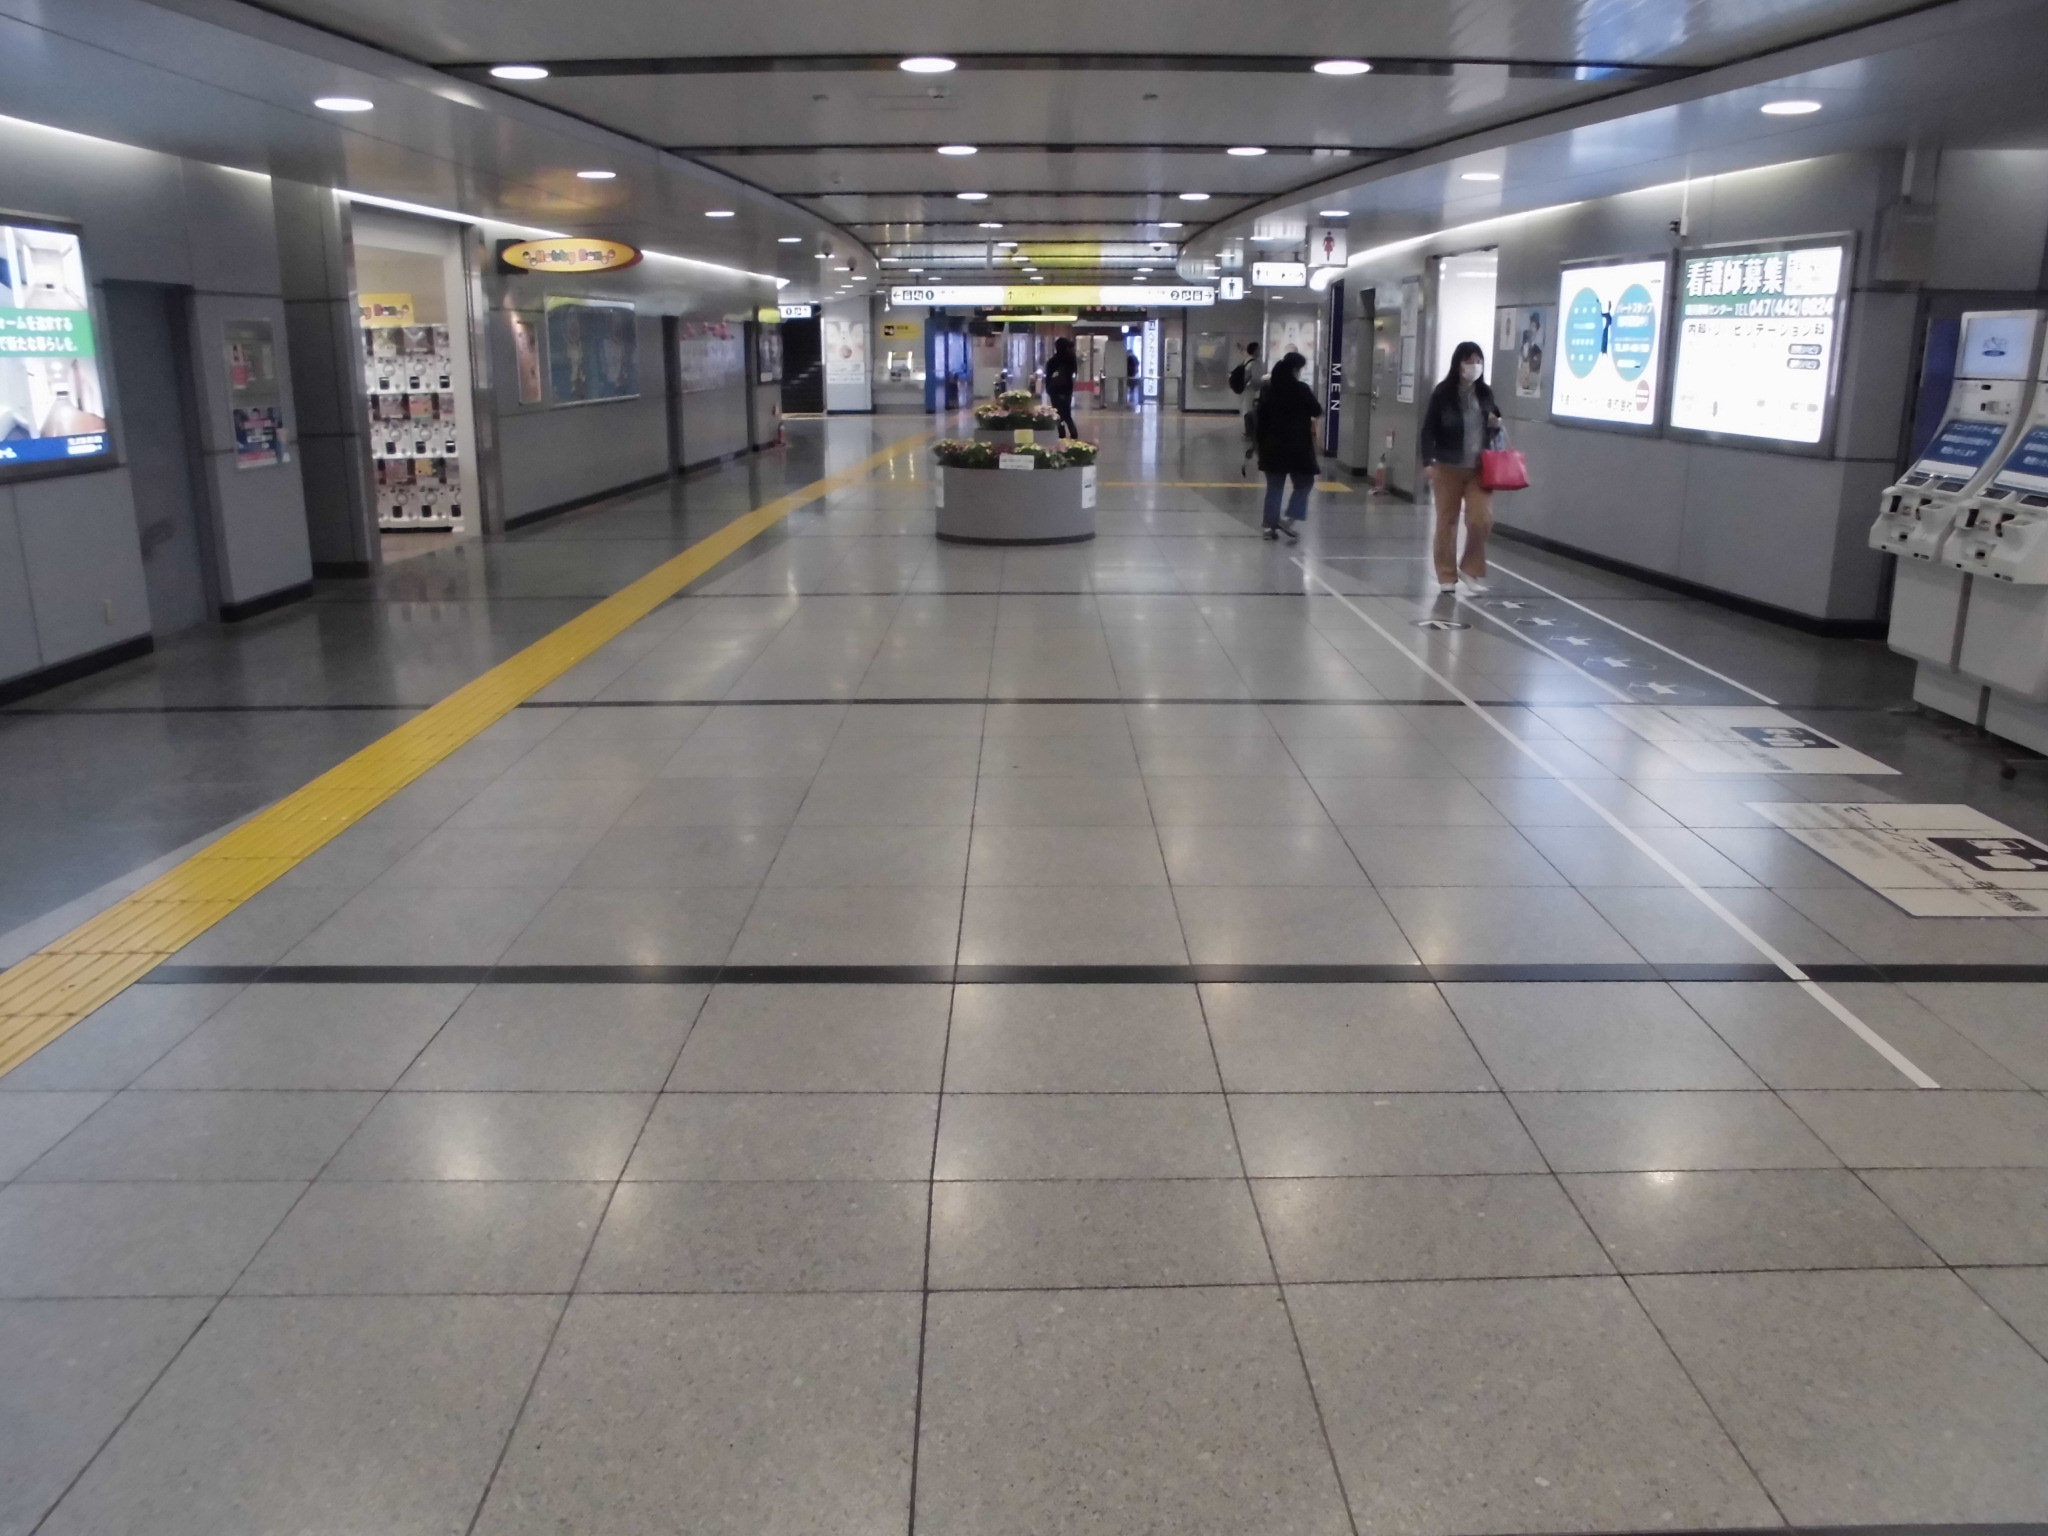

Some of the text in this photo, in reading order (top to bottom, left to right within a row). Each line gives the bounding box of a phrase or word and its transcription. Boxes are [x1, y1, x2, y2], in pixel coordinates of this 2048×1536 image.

[1686, 256, 1784, 297] 看護師募集
[1331, 363, 1342, 411] MEN
